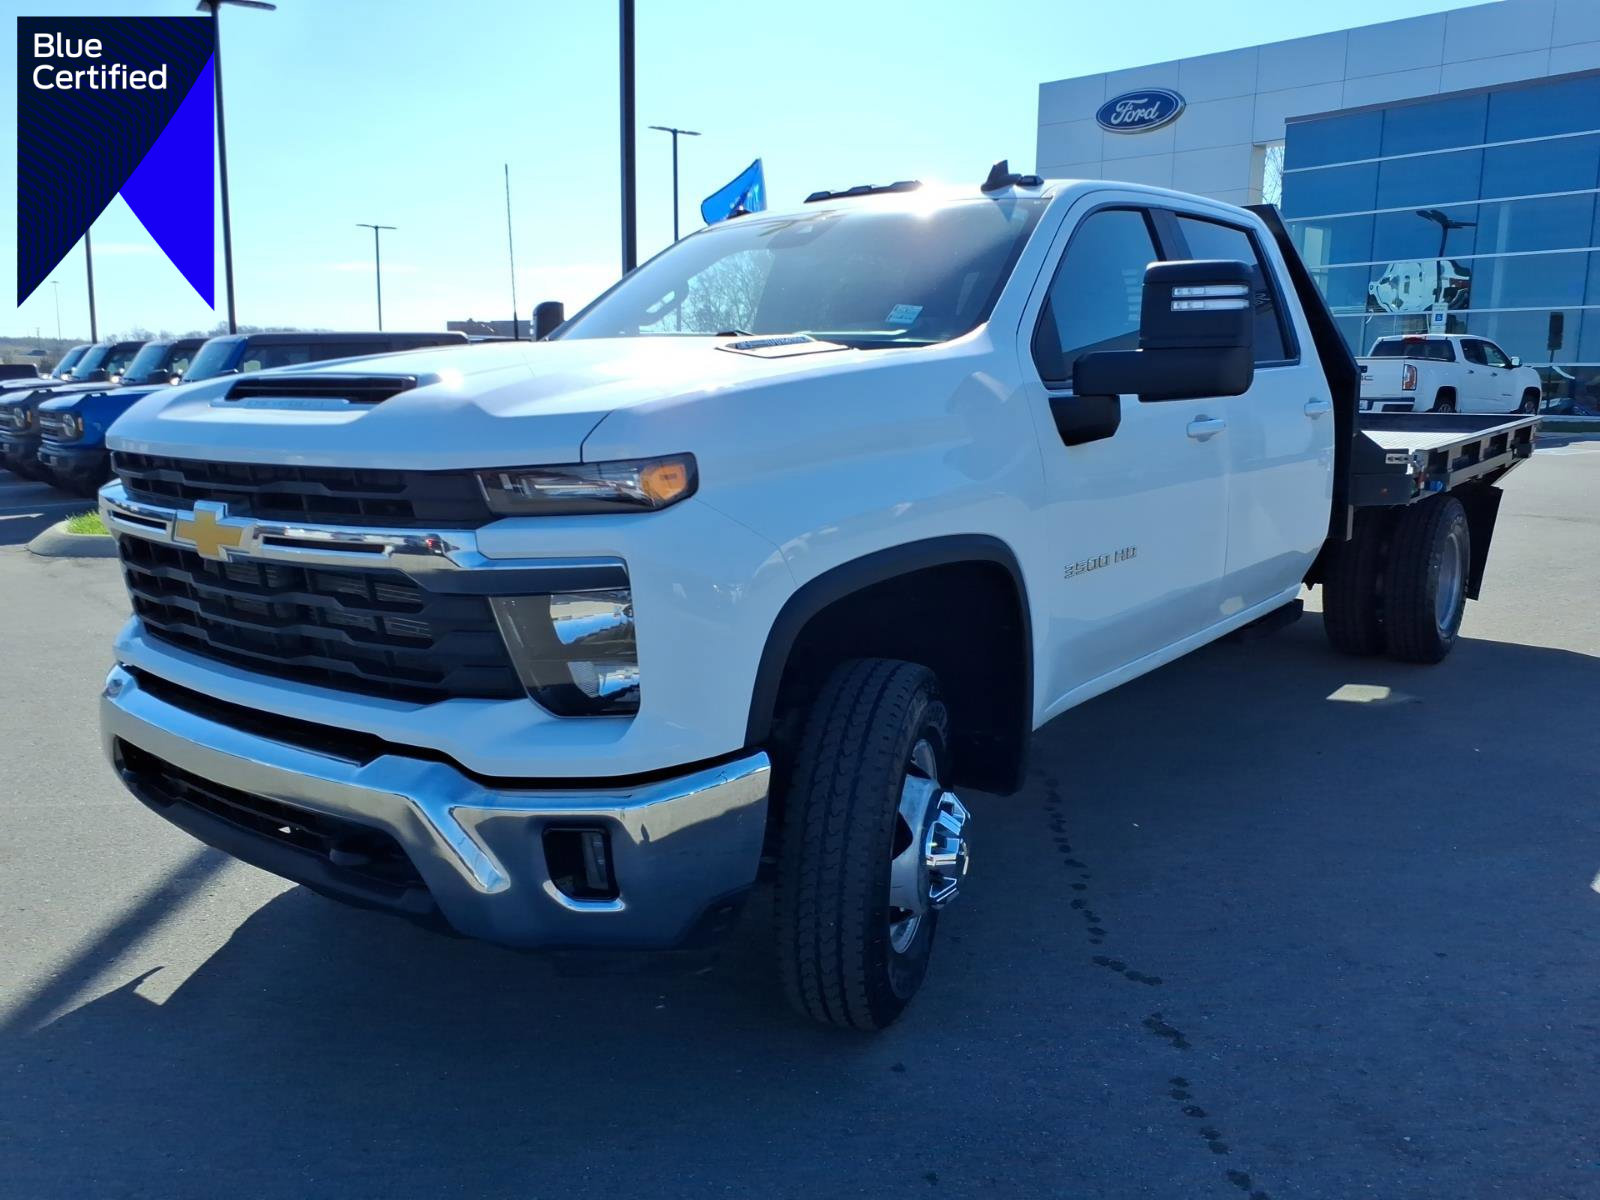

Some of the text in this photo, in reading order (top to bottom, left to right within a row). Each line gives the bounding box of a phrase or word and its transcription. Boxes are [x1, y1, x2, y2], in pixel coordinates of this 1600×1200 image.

[1110, 98, 1161, 125] Ford
[1063, 546, 1137, 580] 3500 HD
